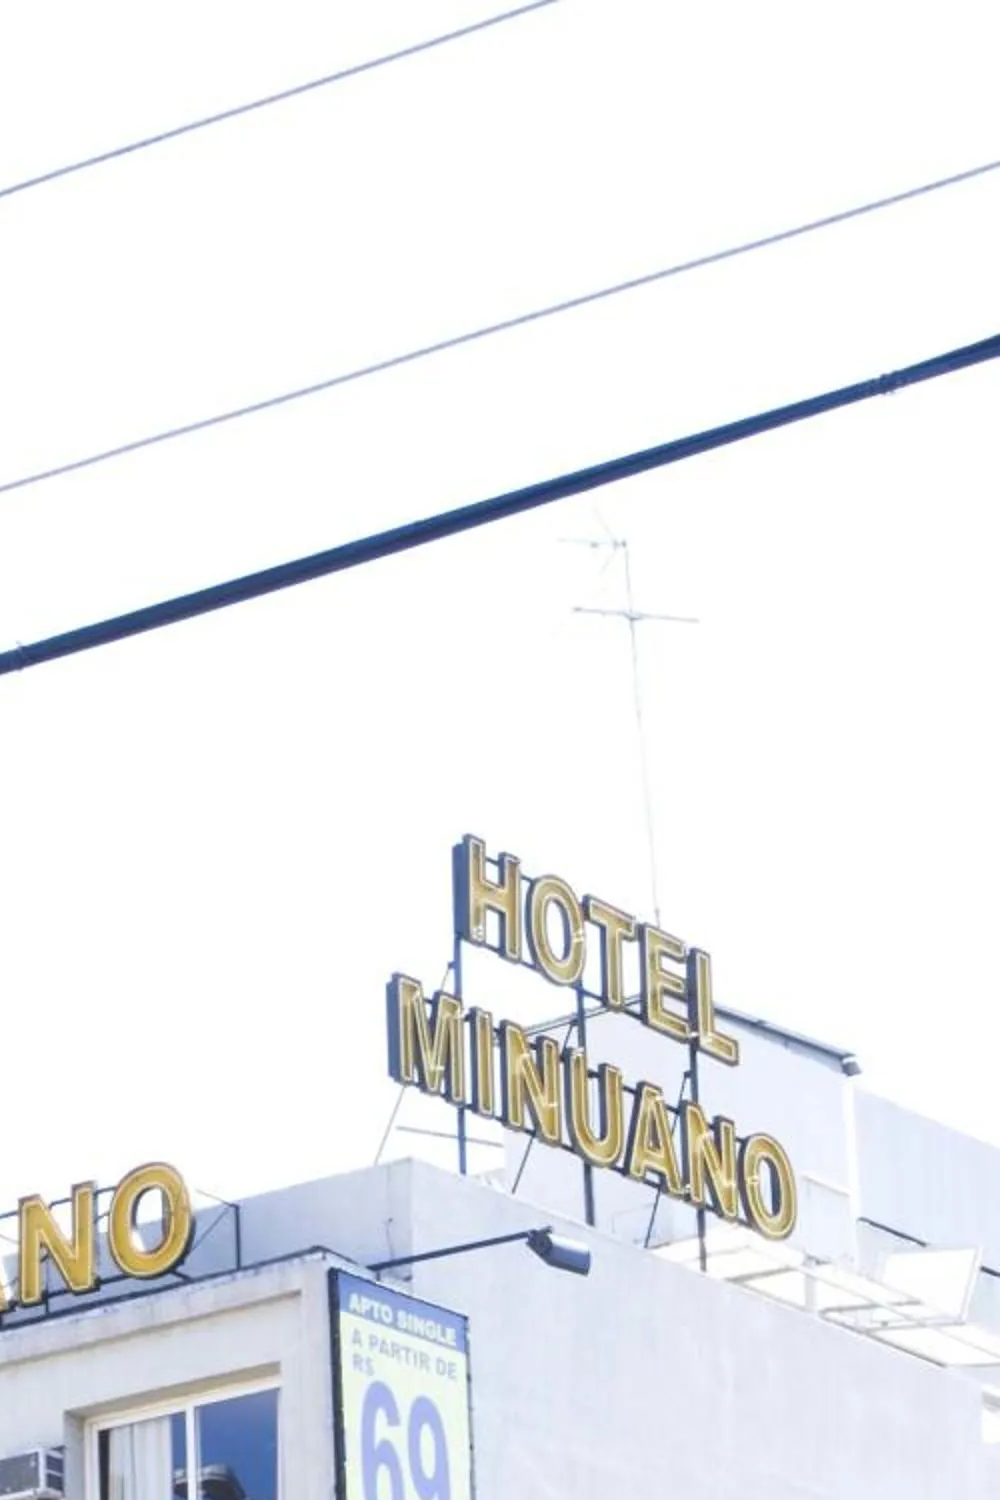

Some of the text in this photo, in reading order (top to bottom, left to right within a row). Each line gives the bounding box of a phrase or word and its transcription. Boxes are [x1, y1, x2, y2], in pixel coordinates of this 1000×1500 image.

[453, 834, 739, 1066] HOTEL
[387, 973, 797, 1239] MINUANO
[349, 1293, 457, 1347] APTO SINGLE
[352, 1328, 458, 1380] A PARTIR DE
